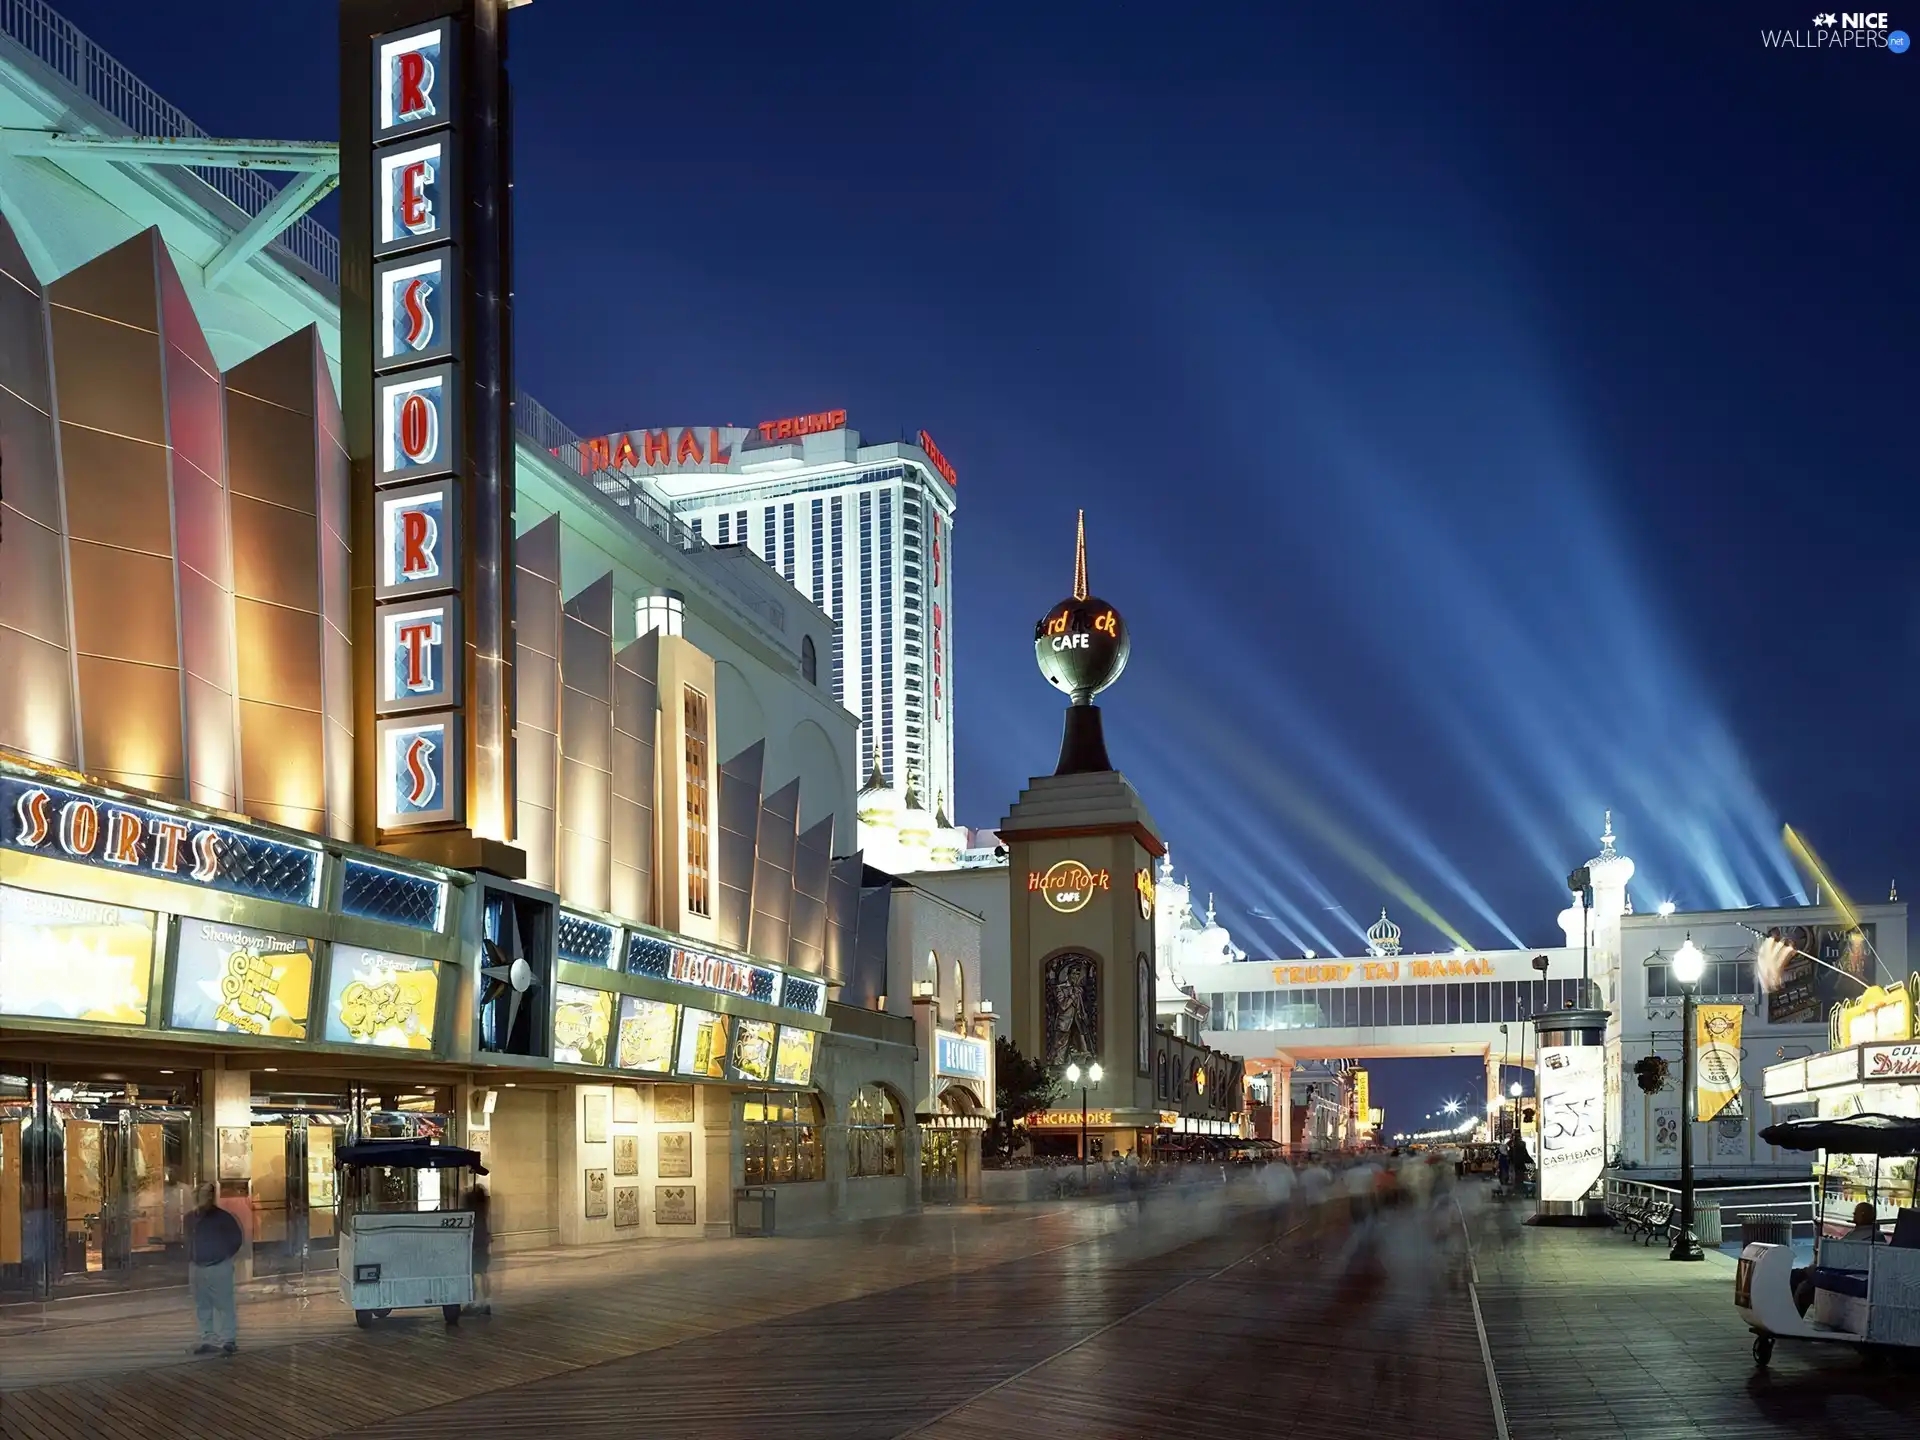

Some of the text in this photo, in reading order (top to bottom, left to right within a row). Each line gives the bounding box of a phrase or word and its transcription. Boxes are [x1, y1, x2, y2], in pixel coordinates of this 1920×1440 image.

[398, 51, 441, 808] RESORTS
[758, 408, 847, 440] TRUMP
[1052, 633, 1090, 652] CAFE
[16, 789, 219, 882] SORTS
[1028, 868, 1110, 890] Hard Rock
[1056, 892, 1080, 903] CAFE
[201, 925, 264, 949] Showdown
[1362, 961, 1399, 981] TAJ
